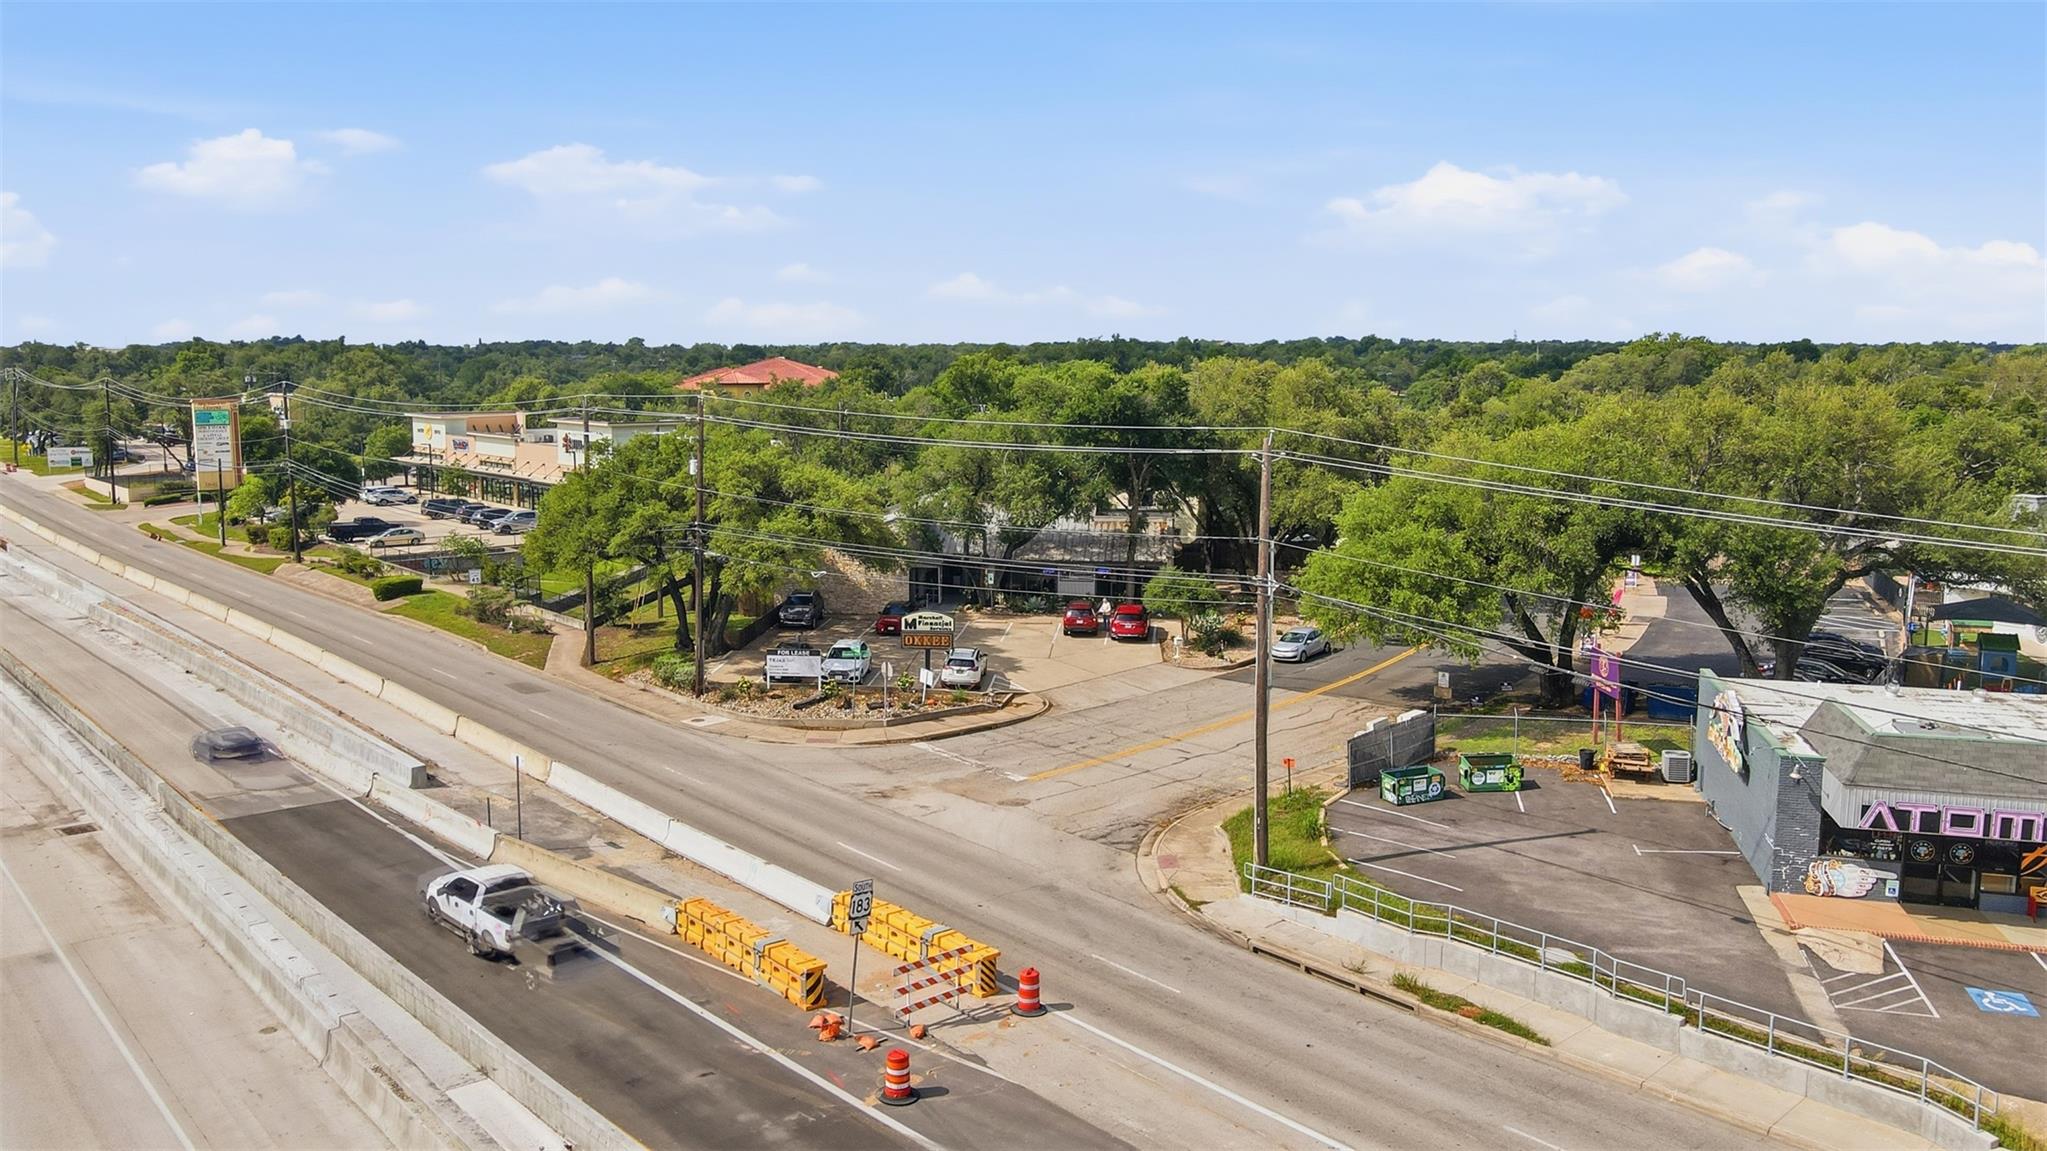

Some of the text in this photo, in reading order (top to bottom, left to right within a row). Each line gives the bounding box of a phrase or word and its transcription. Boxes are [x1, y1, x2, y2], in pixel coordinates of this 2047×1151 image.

[904, 618, 917, 629] M
[854, 882, 872, 892] SOUTH
[852, 896, 870, 914] 183
